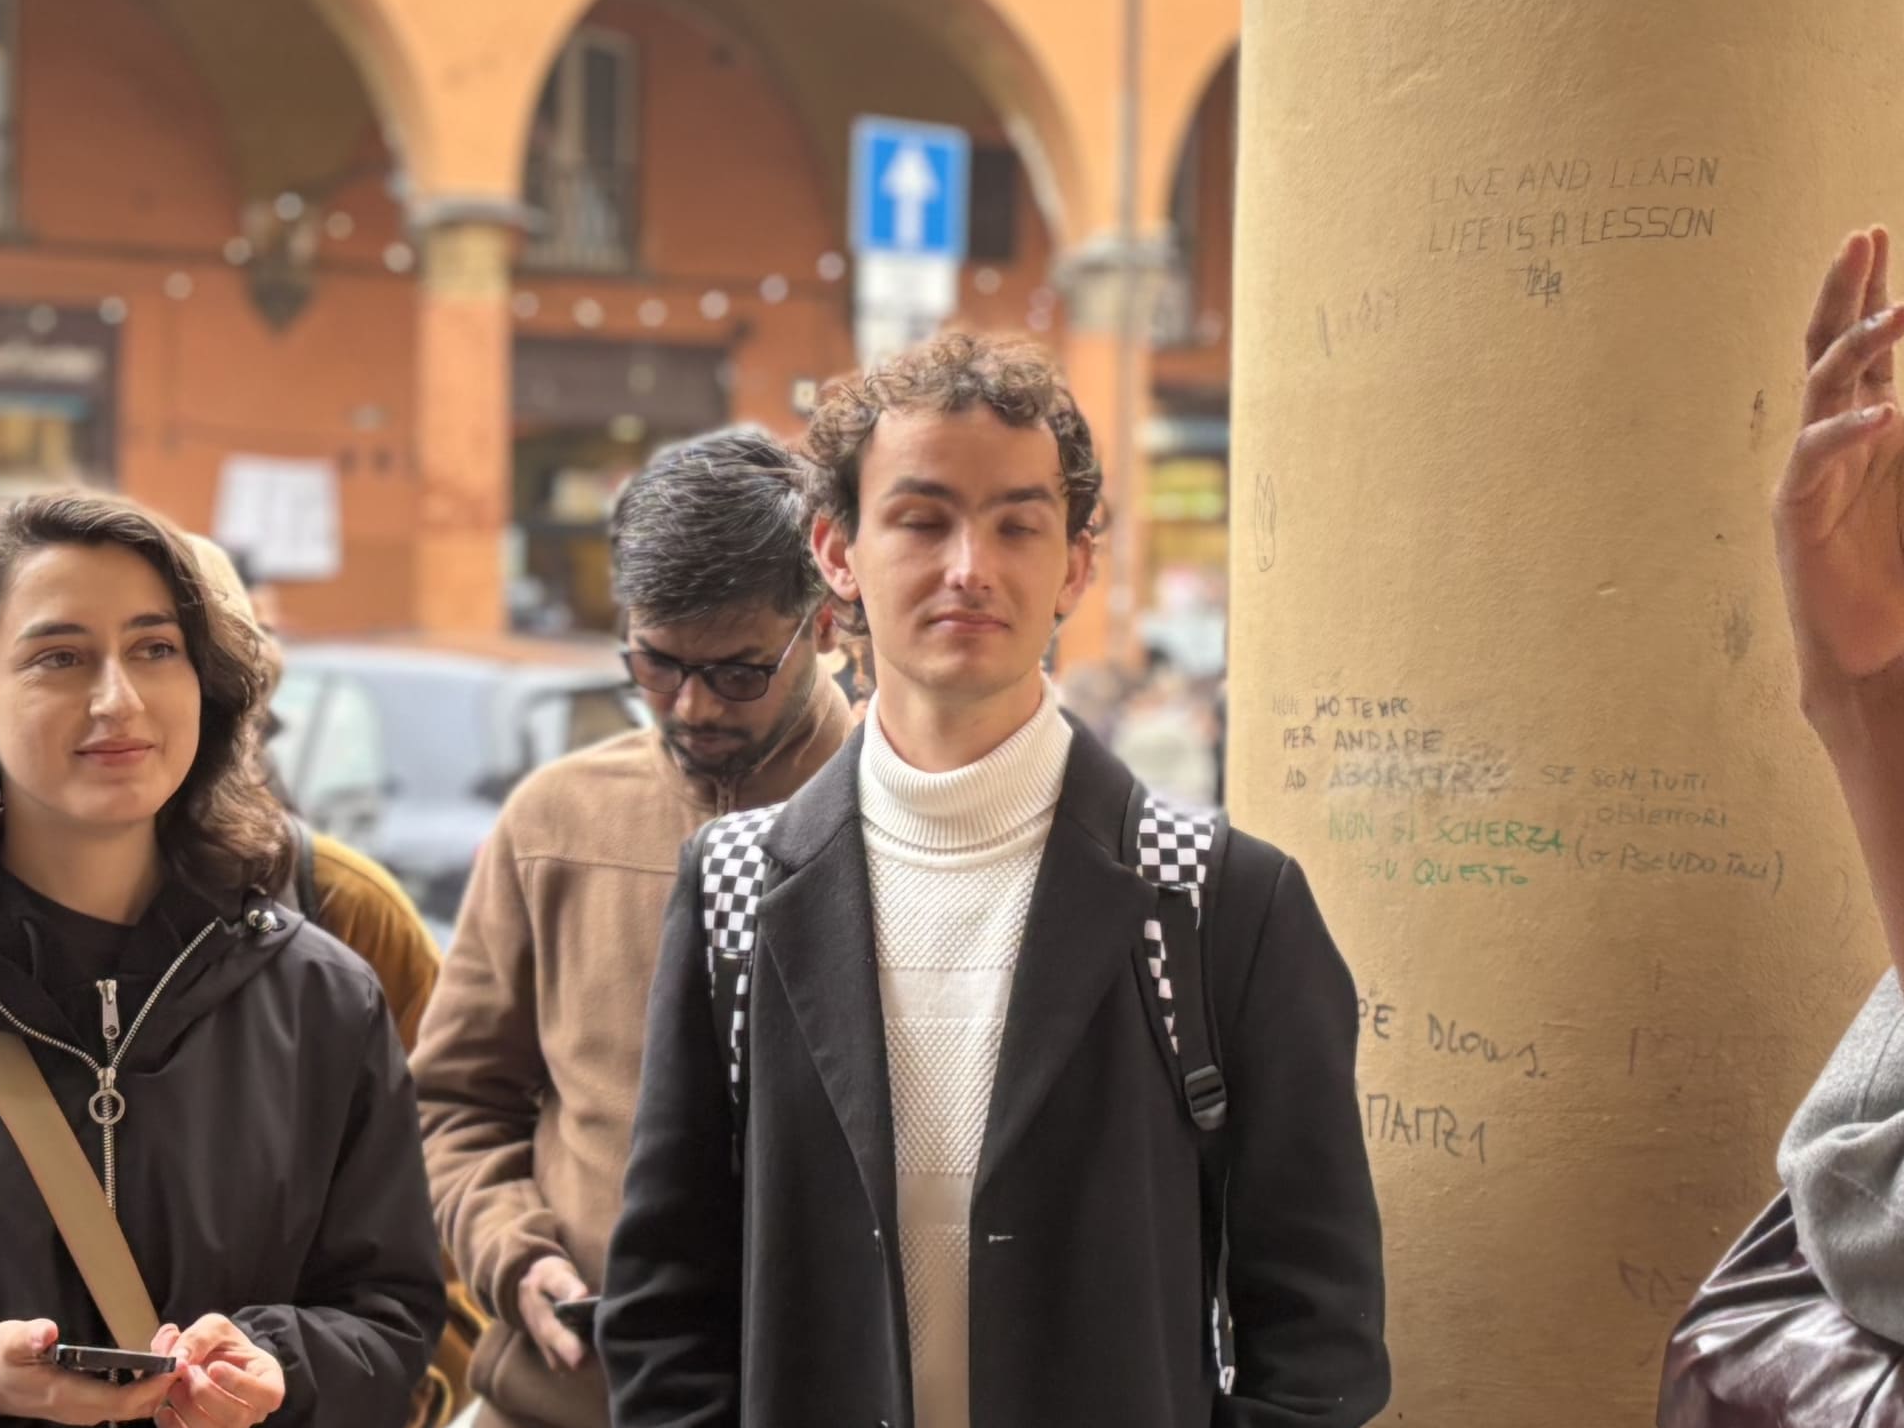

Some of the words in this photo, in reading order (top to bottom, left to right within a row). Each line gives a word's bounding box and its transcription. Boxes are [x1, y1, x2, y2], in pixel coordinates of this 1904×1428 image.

[1429, 167, 1504, 204] LIVE
[1517, 159, 1591, 194] AND
[1609, 156, 1720, 189] LEARN
[1429, 216, 1495, 253] LIFE
[1505, 215, 1537, 251] IS
[1549, 210, 1568, 248] A
[1581, 206, 1715, 245] LESSON
[1314, 696, 1341, 719] HO
[1283, 725, 1317, 750] PER
[1333, 728, 1444, 753] ANDARE
[1285, 765, 1308, 790] AD
[1328, 810, 1375, 844] NON
[1433, 818, 1565, 856] SCHERZA
[1412, 858, 1530, 886] QUESTO
